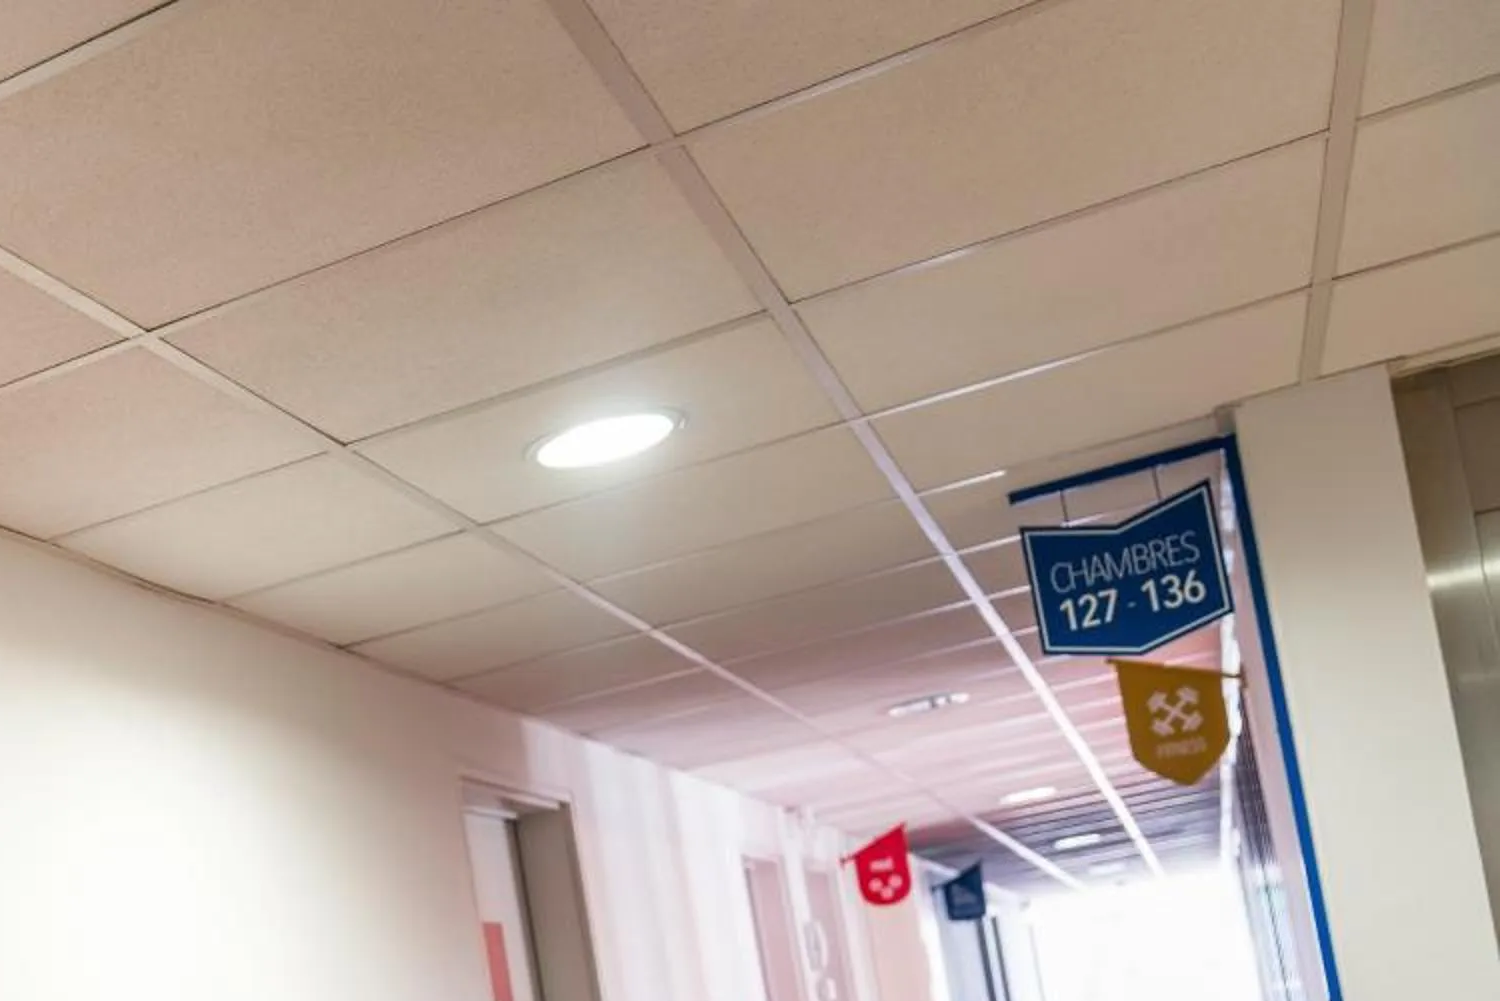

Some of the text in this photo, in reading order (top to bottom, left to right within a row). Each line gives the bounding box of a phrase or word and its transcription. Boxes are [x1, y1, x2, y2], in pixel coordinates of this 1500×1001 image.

[1051, 530, 1201, 593] CHAMBRES
[1059, 588, 1118, 631] 127
[1141, 569, 1207, 612] 136
